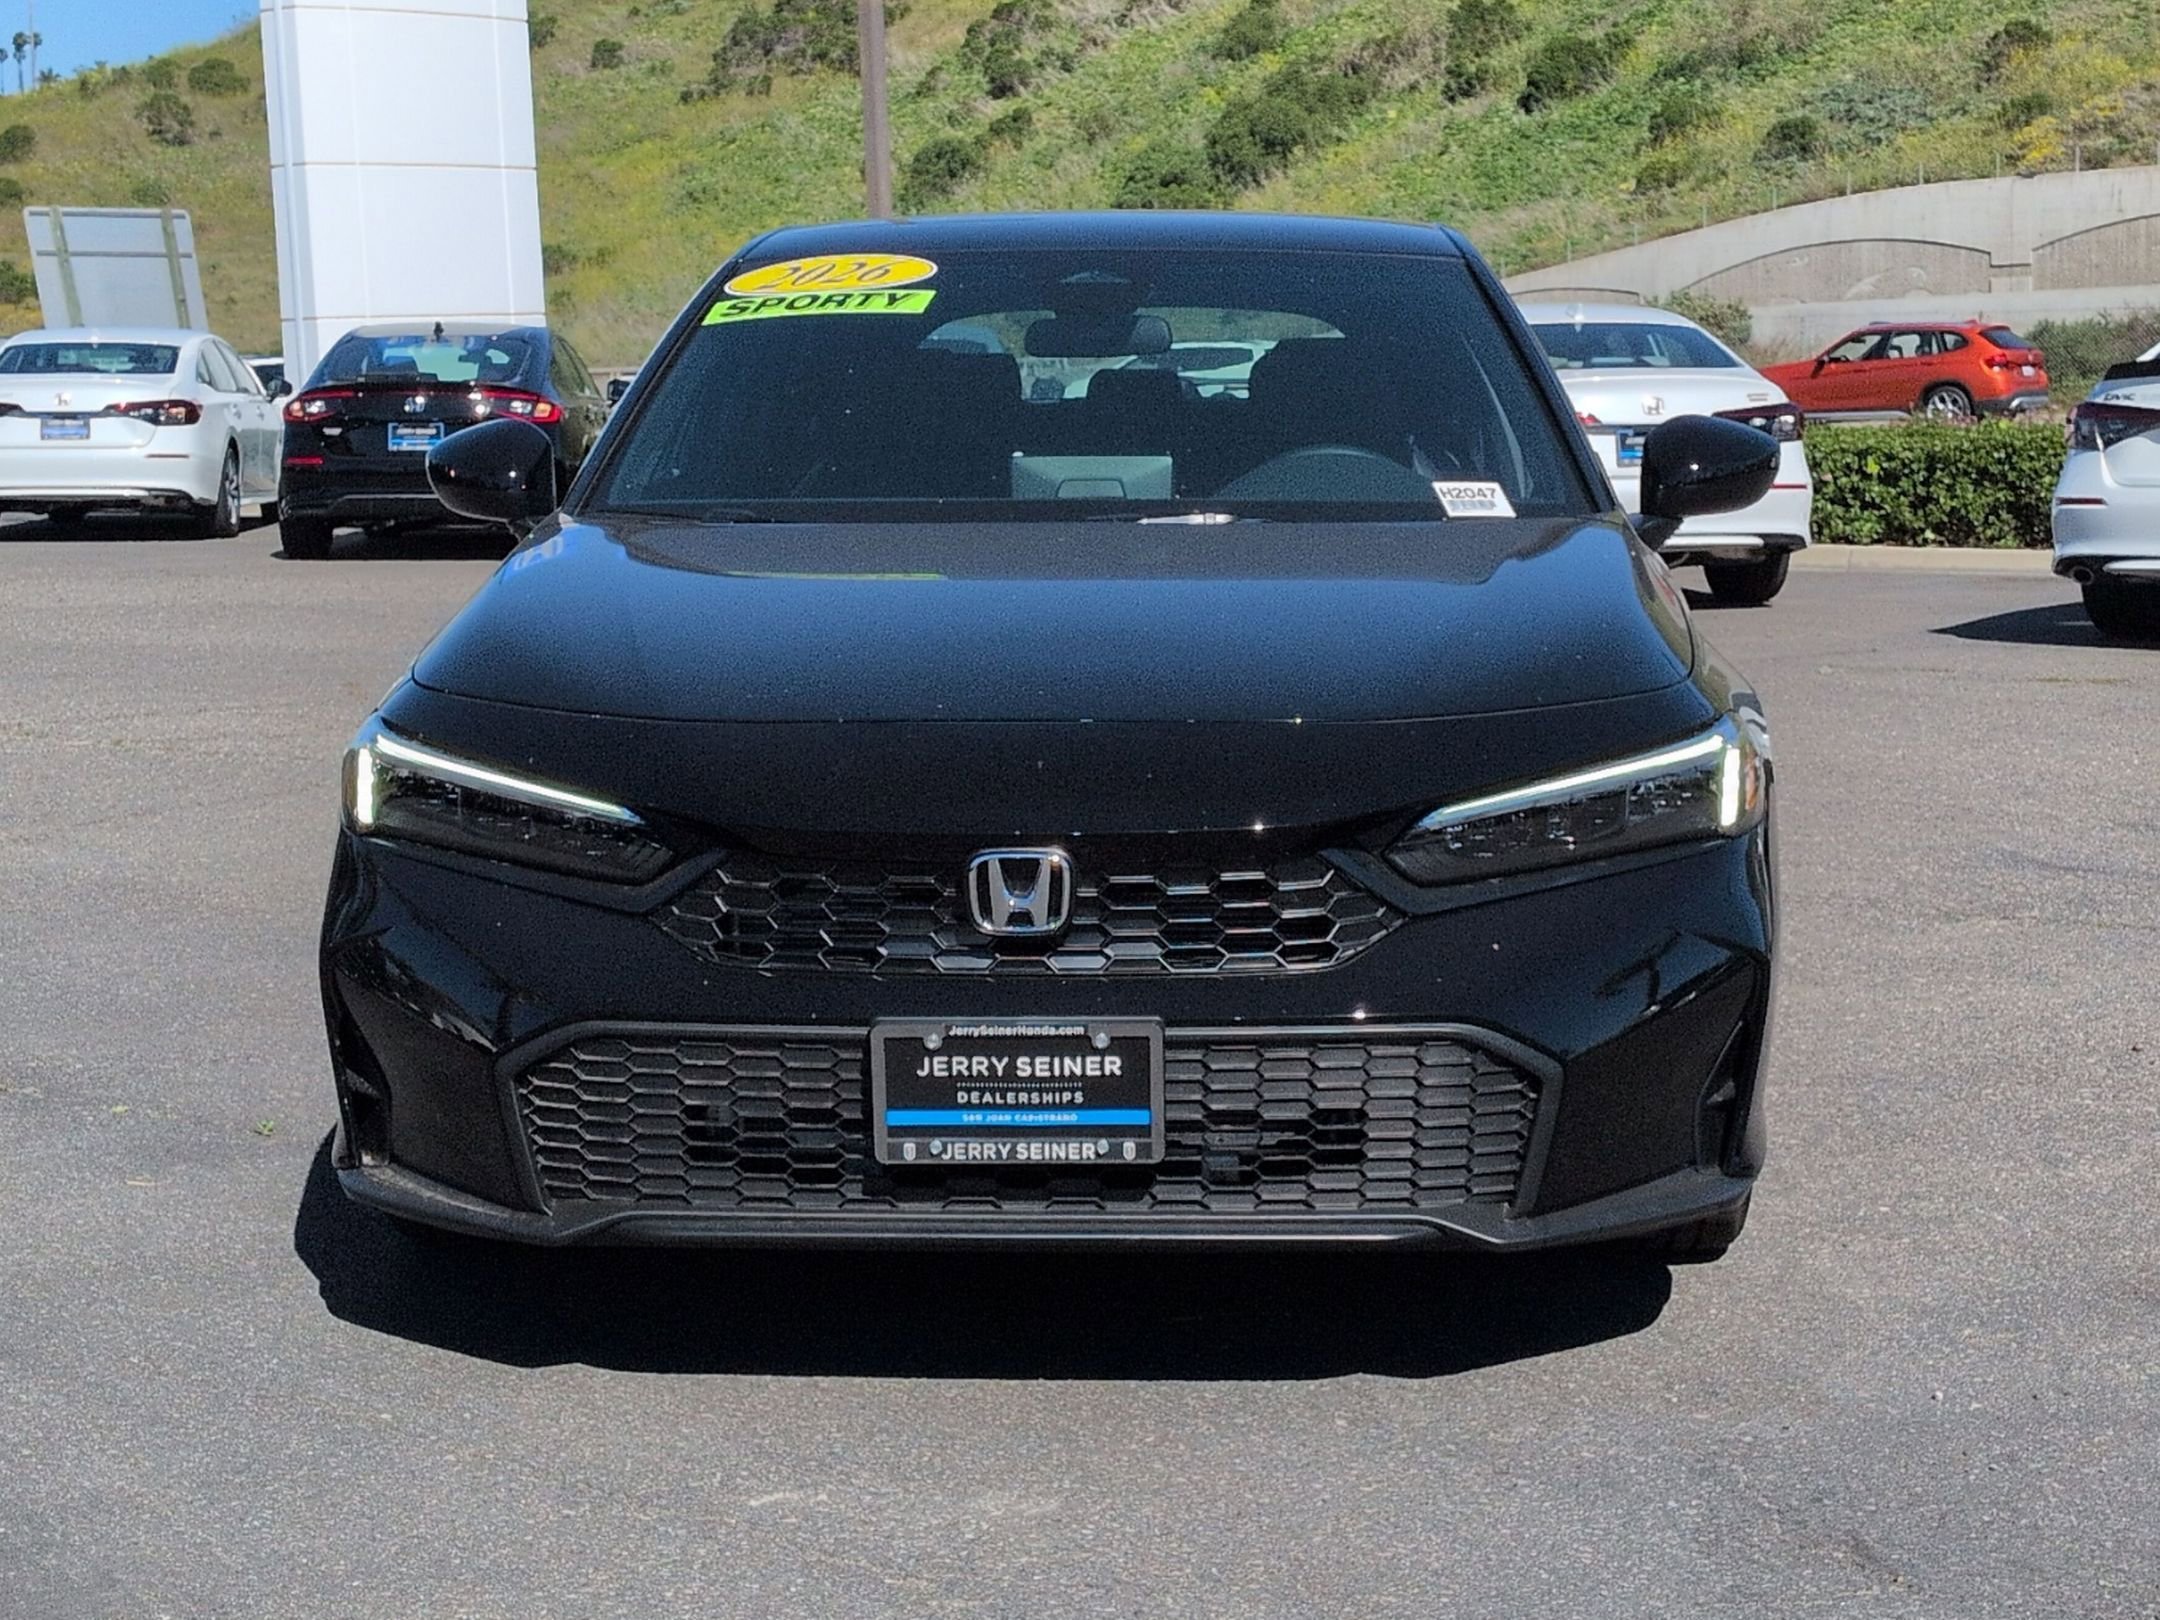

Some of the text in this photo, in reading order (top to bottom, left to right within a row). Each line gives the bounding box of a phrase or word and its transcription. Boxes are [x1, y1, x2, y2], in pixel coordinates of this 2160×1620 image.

[754, 261, 907, 289] 2026
[720, 293, 914, 315] SPORTY
[1439, 487, 1496, 499] H2047
[916, 1055, 1122, 1077] JERRY SEINER
[956, 1090, 1084, 1104] DEALERSHIPS
[941, 1142, 1096, 1160] JERRY SEINER
